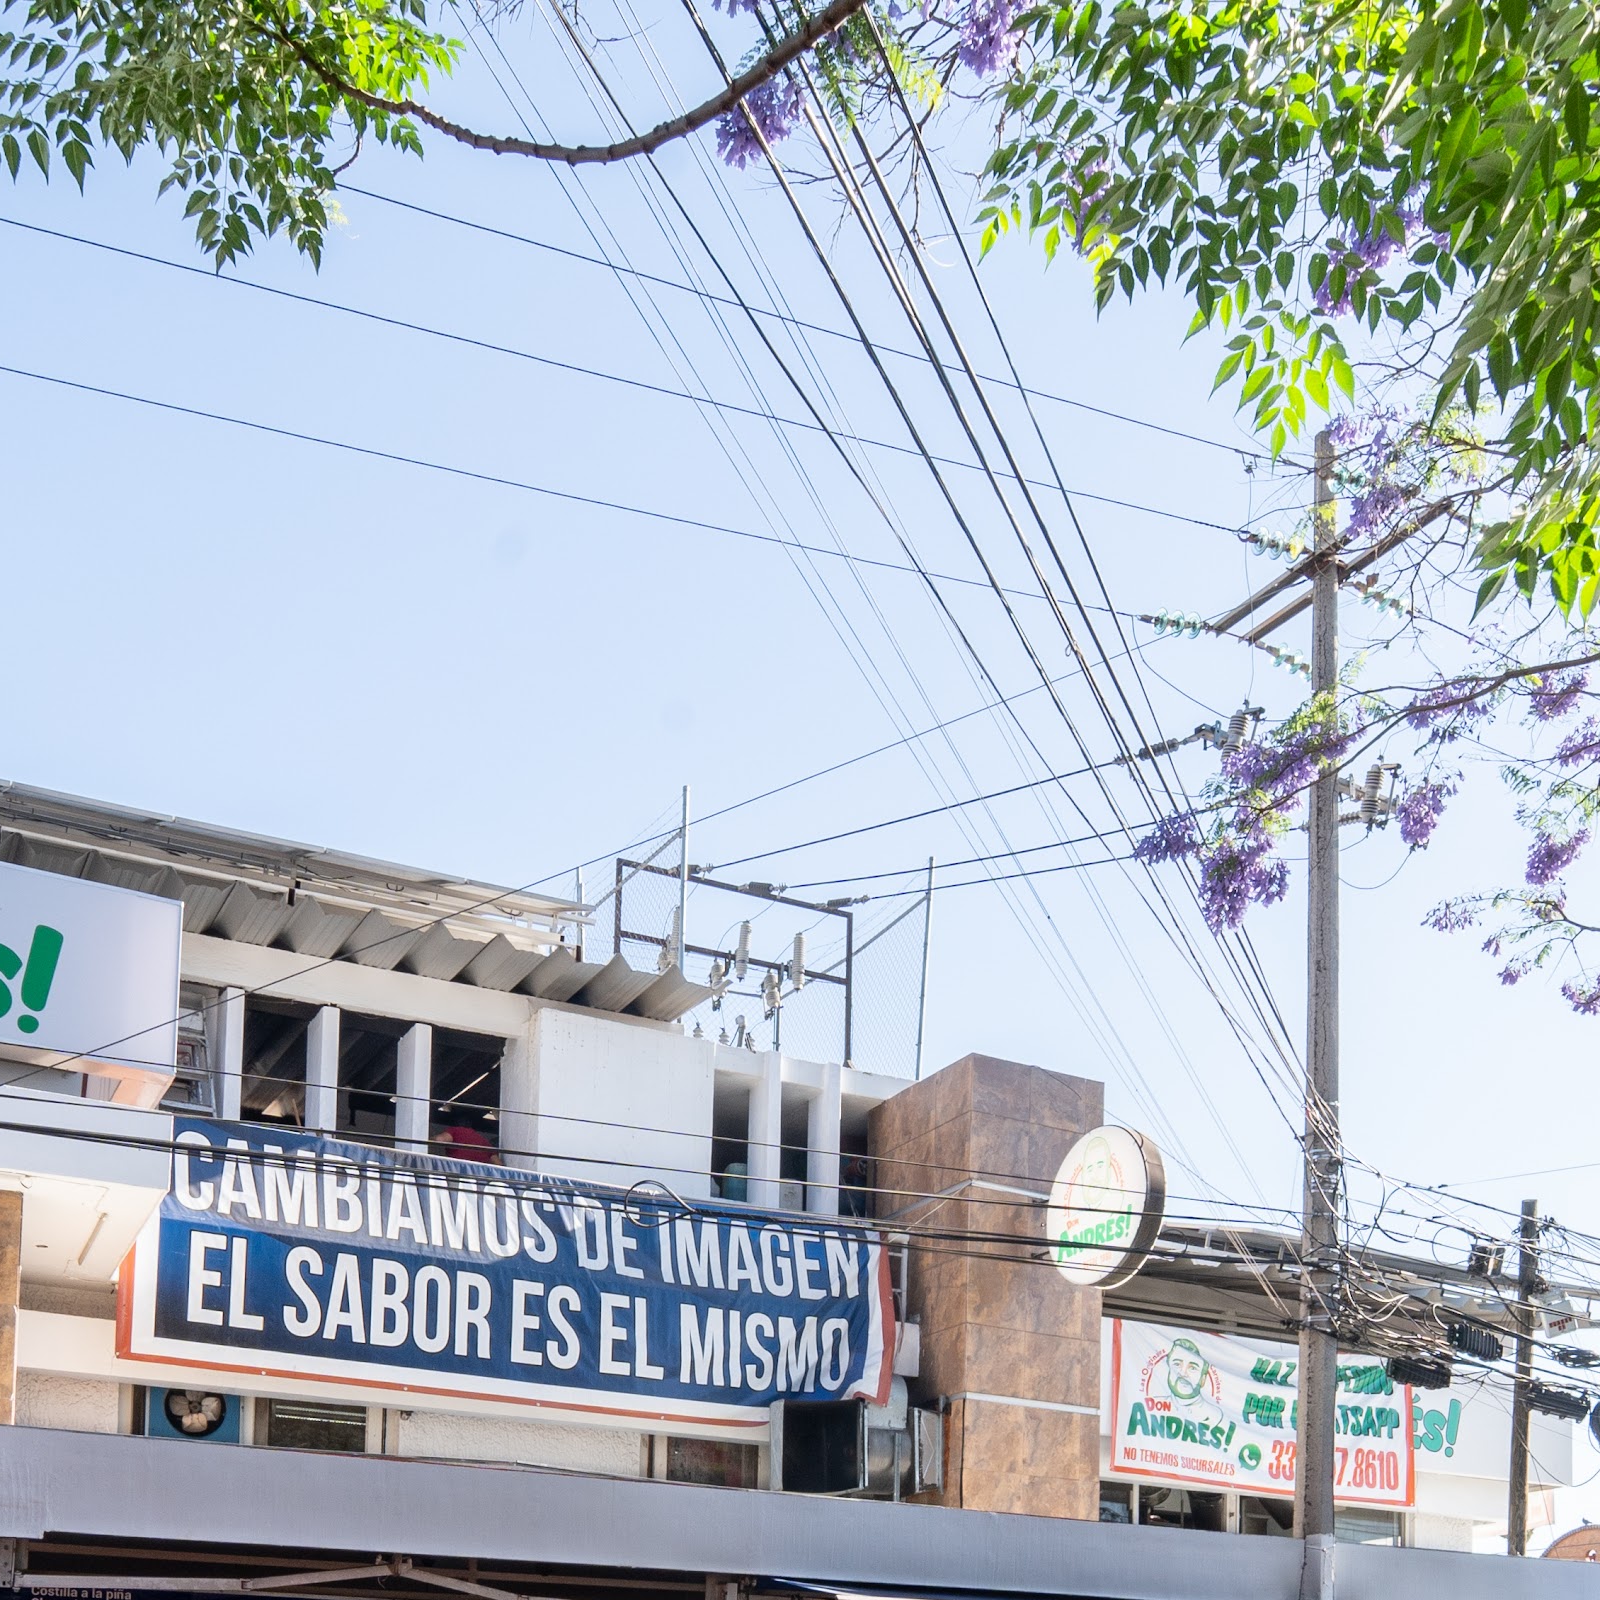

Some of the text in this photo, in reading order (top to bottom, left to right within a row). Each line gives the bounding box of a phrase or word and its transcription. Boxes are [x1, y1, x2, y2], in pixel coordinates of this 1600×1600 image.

[173, 1129, 865, 1301] CAMBIAMOS DE IMAGEN
[186, 1229, 850, 1393] EL SABOR ES EL MISMO
[1250, 1357, 1297, 1388] HAZ
[1145, 1397, 1171, 1412] DON
[1242, 1392, 1286, 1429] POR
[1126, 1402, 1237, 1453] ANDRÉS!
[1123, 1447, 1236, 1476] NO TENEMOS SUCURSALES
[31, 1587, 132, 1600] Costilla piña
